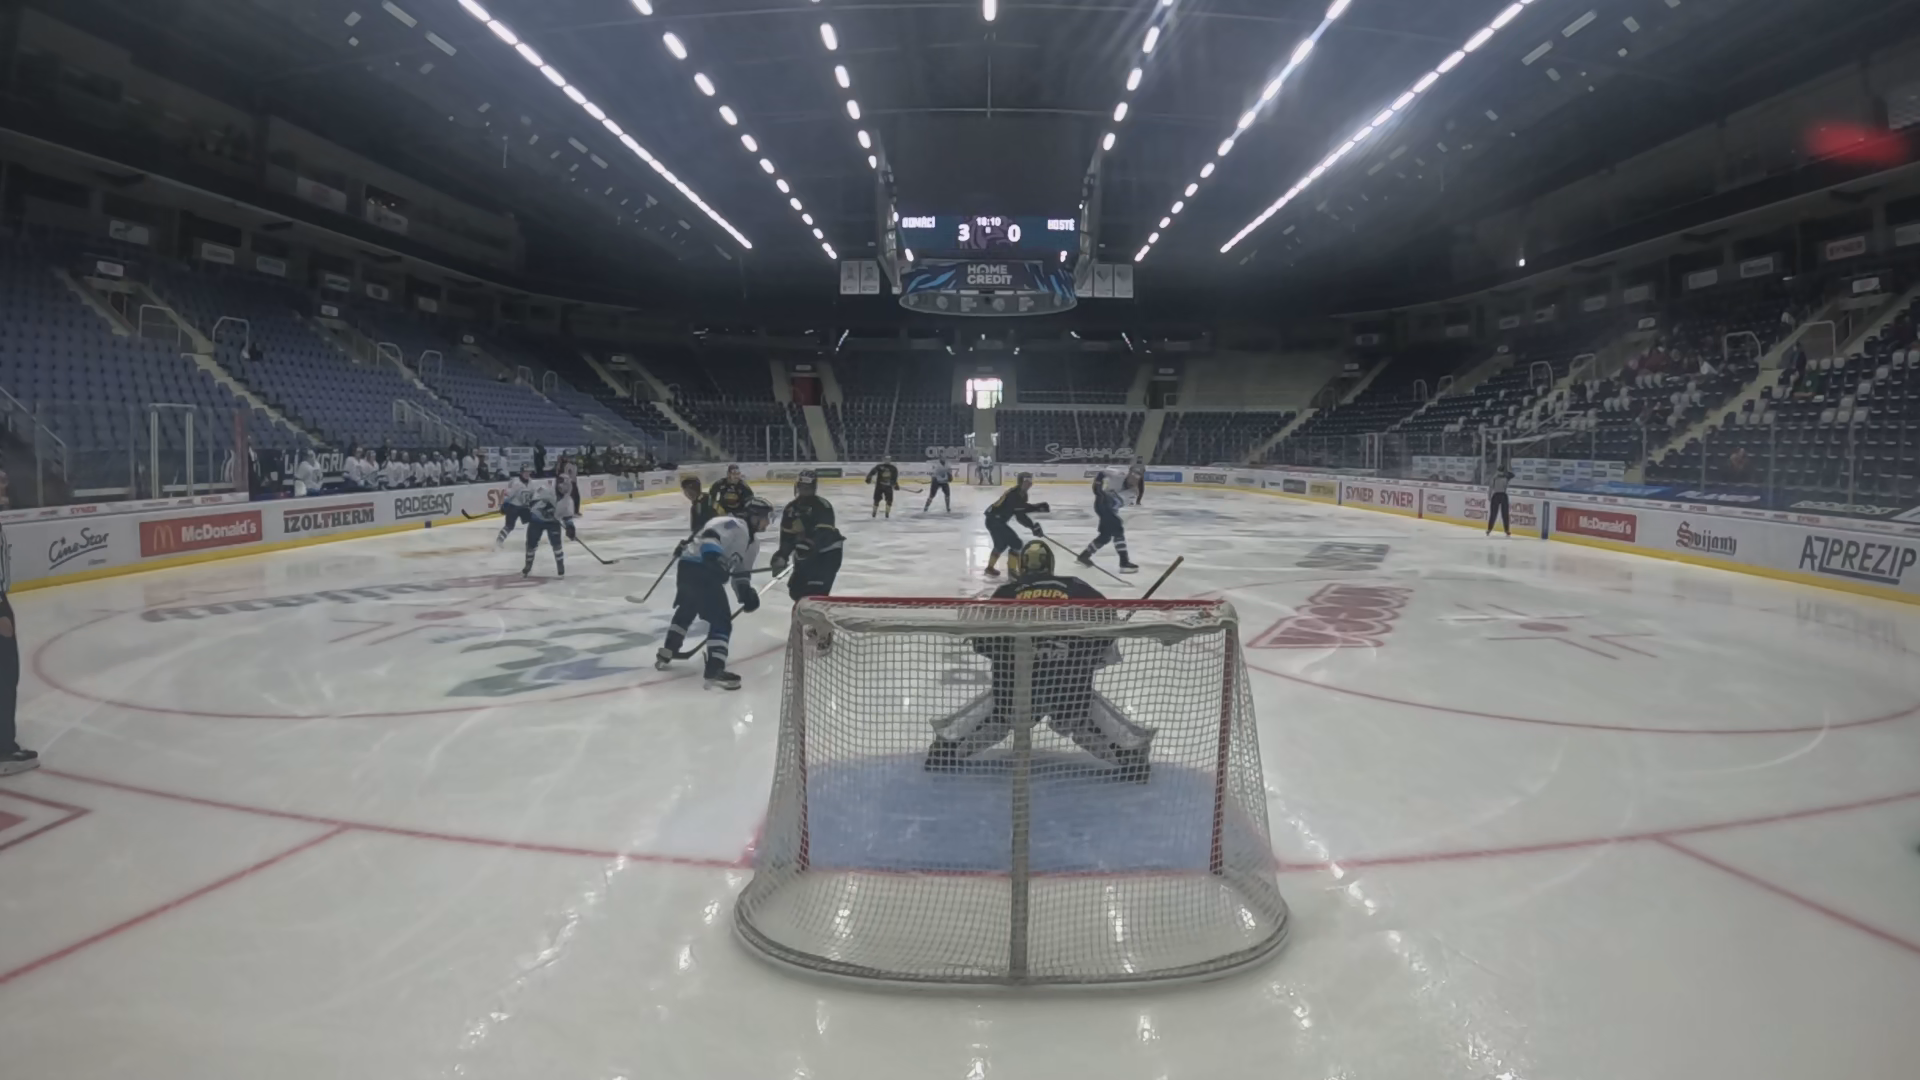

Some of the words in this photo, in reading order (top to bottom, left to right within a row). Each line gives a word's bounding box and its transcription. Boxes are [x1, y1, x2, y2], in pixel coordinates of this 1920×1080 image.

[958, 224, 970, 241] 3
[1008, 225, 1021, 242] 0
[968, 264, 1008, 274] HOME
[967, 275, 1012, 285] CREDIT
[394, 492, 454, 519] RADEGAST
[1345, 486, 1374, 504] SYNER
[1380, 489, 1414, 508] SYNER
[284, 509, 374, 533] IZOLTHERM
